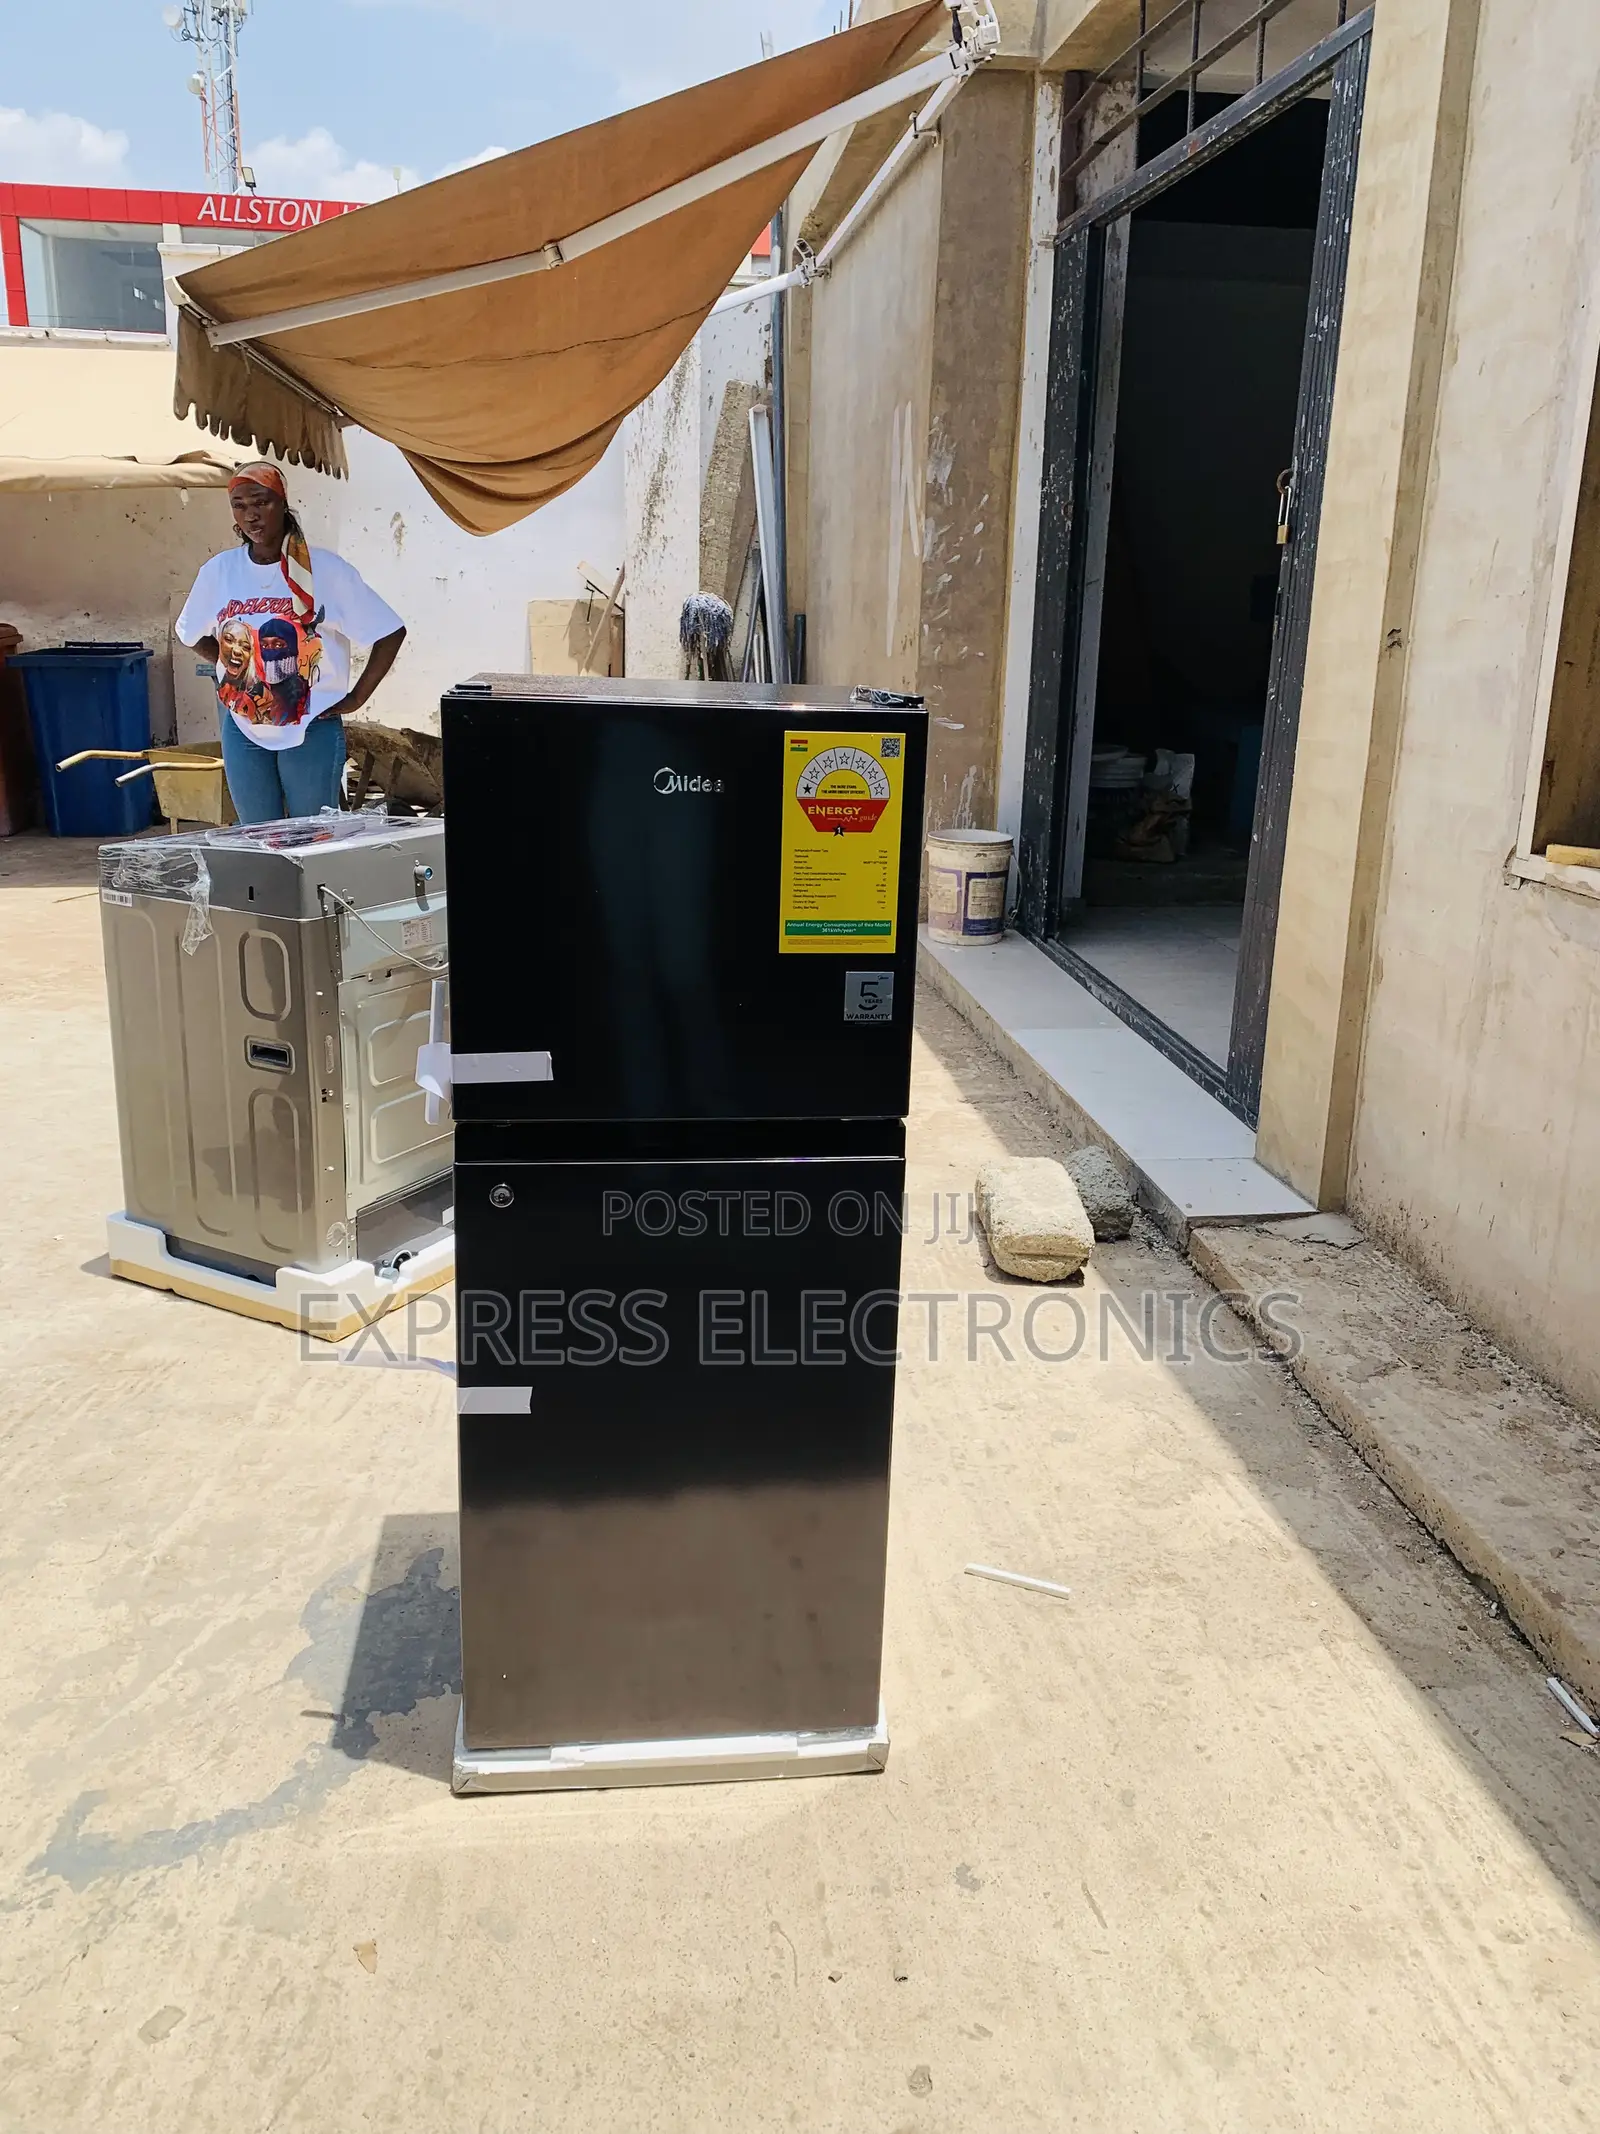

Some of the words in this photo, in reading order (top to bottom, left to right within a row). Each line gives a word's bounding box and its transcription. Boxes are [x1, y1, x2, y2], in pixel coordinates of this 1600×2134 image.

[197, 195, 322, 226] ALLSTON
[807, 804, 862, 817] ENERGY
[858, 981, 879, 1011] 5
